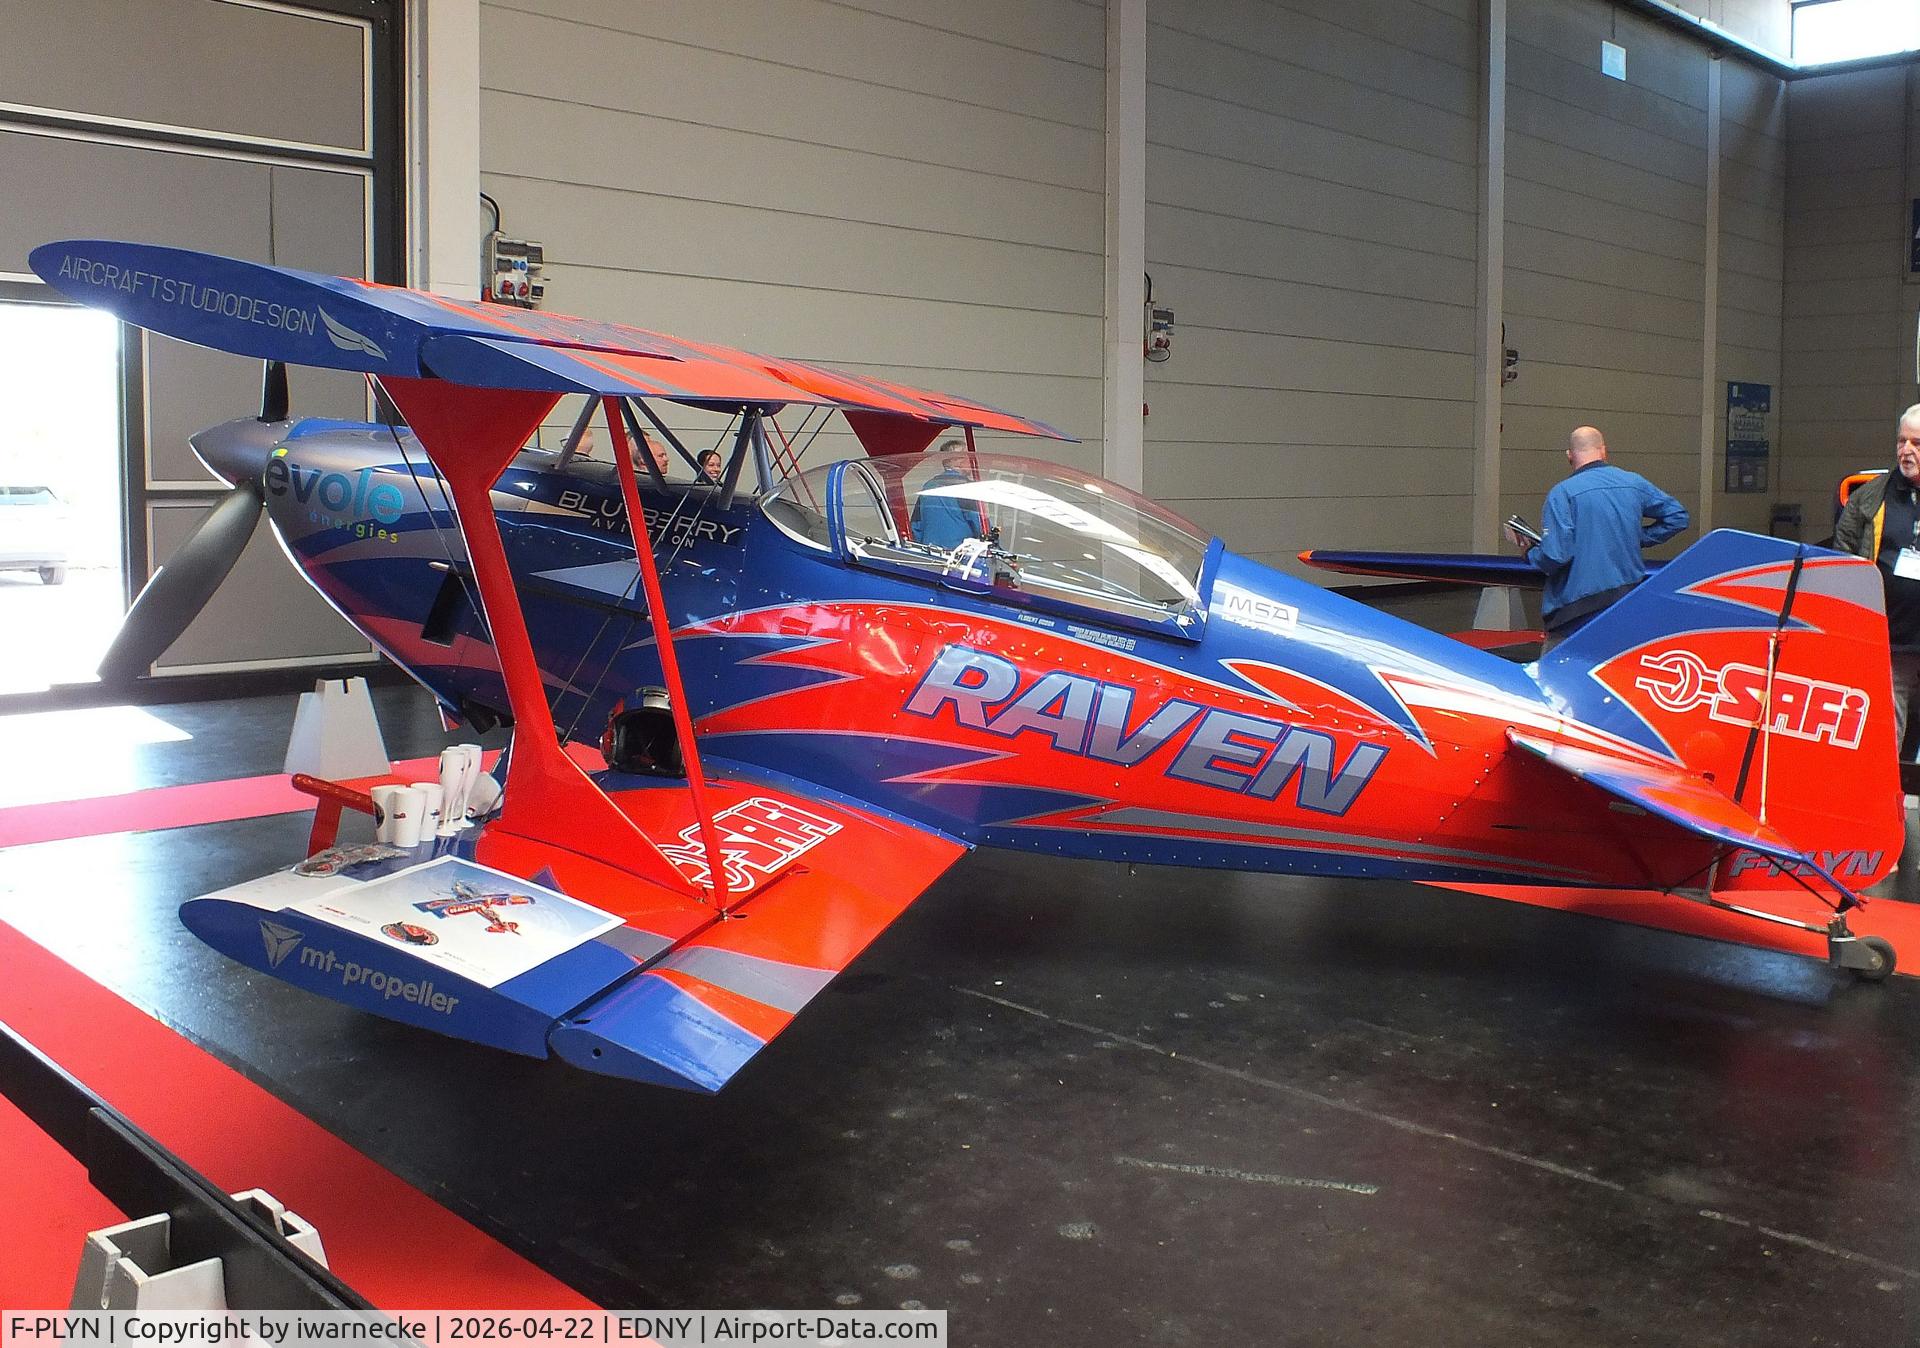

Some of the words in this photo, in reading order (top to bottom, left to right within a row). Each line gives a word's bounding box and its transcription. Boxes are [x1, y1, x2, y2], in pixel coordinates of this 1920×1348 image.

[58, 255, 317, 336] AIRCRAFTSTUDIODESIGN
[310, 511, 398, 544] energies
[558, 490, 740, 543] BLUBERRY
[592, 520, 695, 548] AVITION
[1229, 596, 1290, 622] MSA
[903, 645, 1390, 816] RAVEN
[301, 946, 459, 1015] mt-propeller
